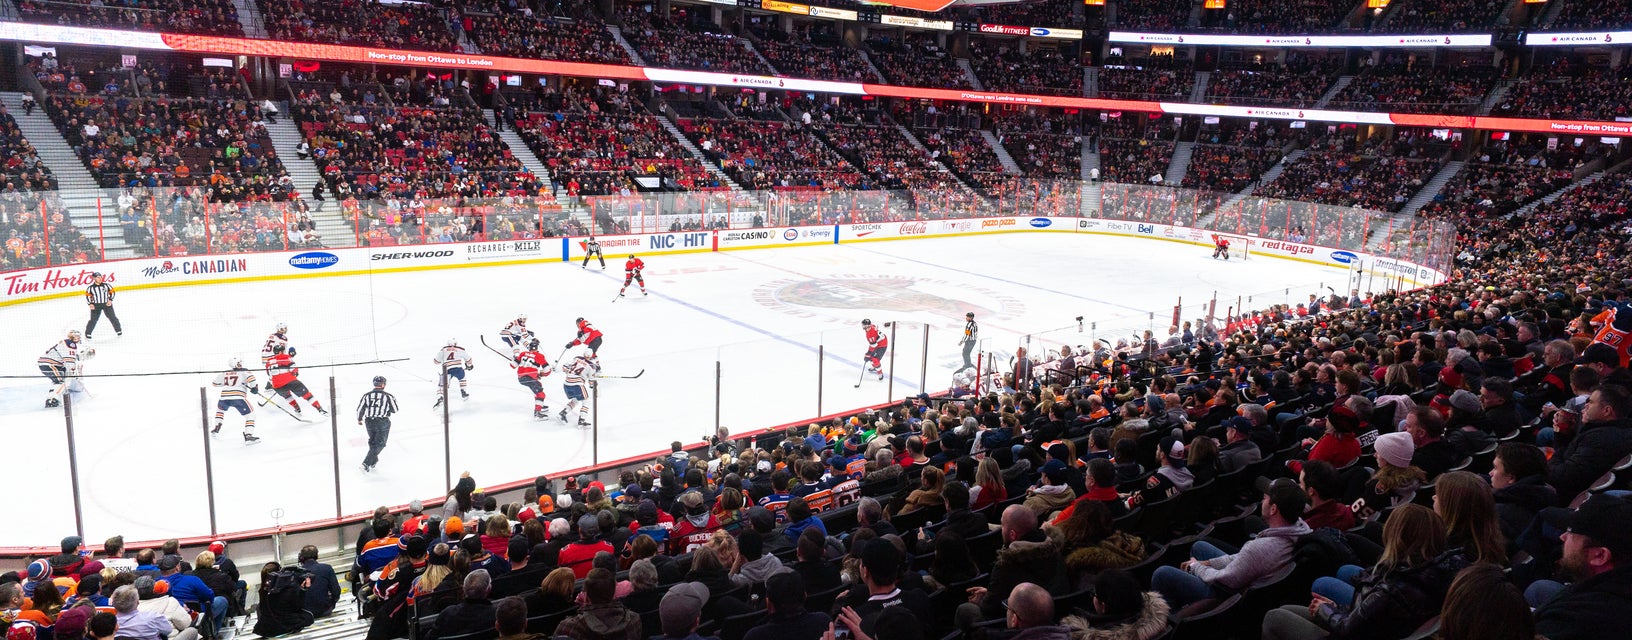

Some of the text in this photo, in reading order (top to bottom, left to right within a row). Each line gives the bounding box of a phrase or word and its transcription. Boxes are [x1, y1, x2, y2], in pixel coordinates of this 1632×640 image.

[368, 51, 406, 62] Non-stop
[407, 54, 426, 62] from
[428, 56, 456, 64] Ottawa
[467, 58, 493, 66] London
[1551, 122, 1582, 132] Non-stop
[982, 218, 1016, 229] pizza pizza
[1138, 224, 1154, 234] Bell
[650, 233, 708, 249] NIC HIT
[741, 232, 768, 240] CASINO
[468, 243, 506, 253] RECHARGE
[515, 241, 540, 252] MILK
[142, 258, 246, 278] Molson CANADIAN
[4, 274, 39, 295] Tim
[1603, 332, 1623, 345] 97
[447, 352, 454, 360] 4
[224, 376, 238, 386] 17
